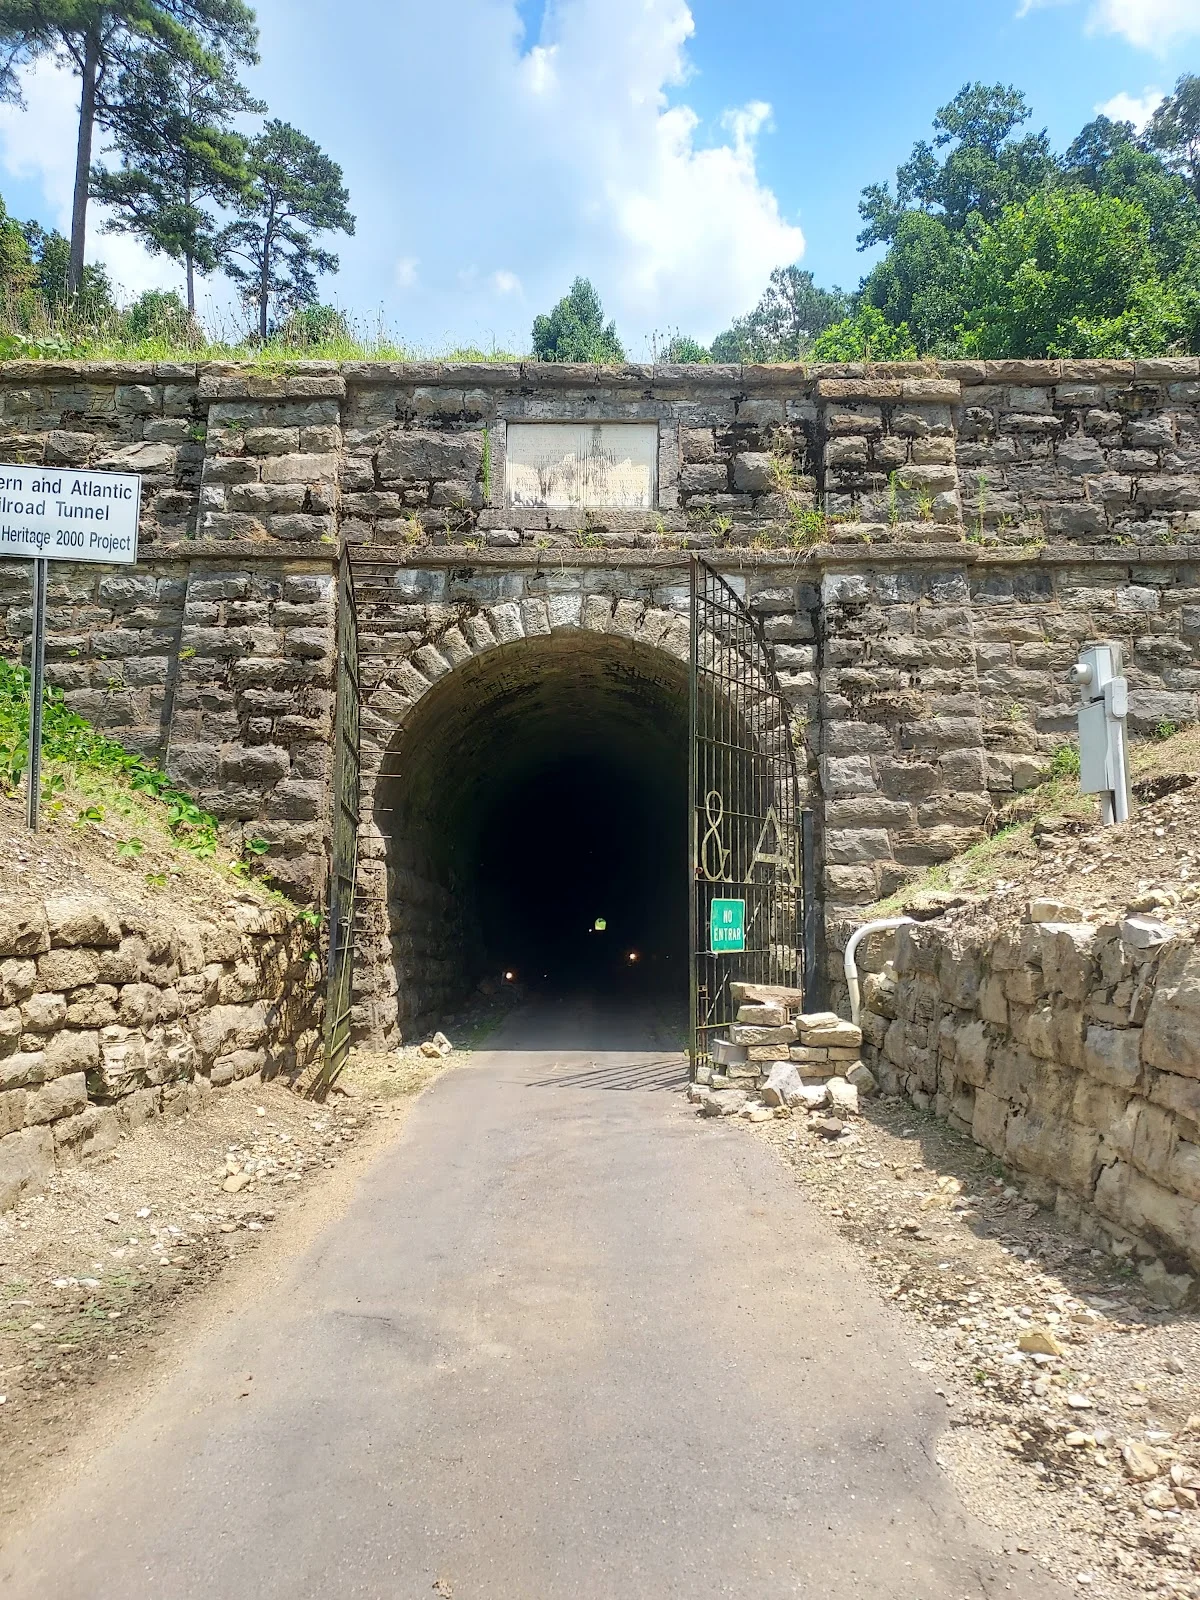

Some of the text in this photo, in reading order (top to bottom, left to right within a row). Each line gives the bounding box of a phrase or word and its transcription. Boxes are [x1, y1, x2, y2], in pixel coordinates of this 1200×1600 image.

[32, 479, 62, 494] and
[71, 480, 133, 500] Atlantic
[56, 501, 110, 521] Tunnel
[2, 525, 131, 553] Heritage 2000 Project
[744, 804, 800, 887] A
[723, 910, 732, 923] NO
[714, 928, 741, 941] ENTRAR
